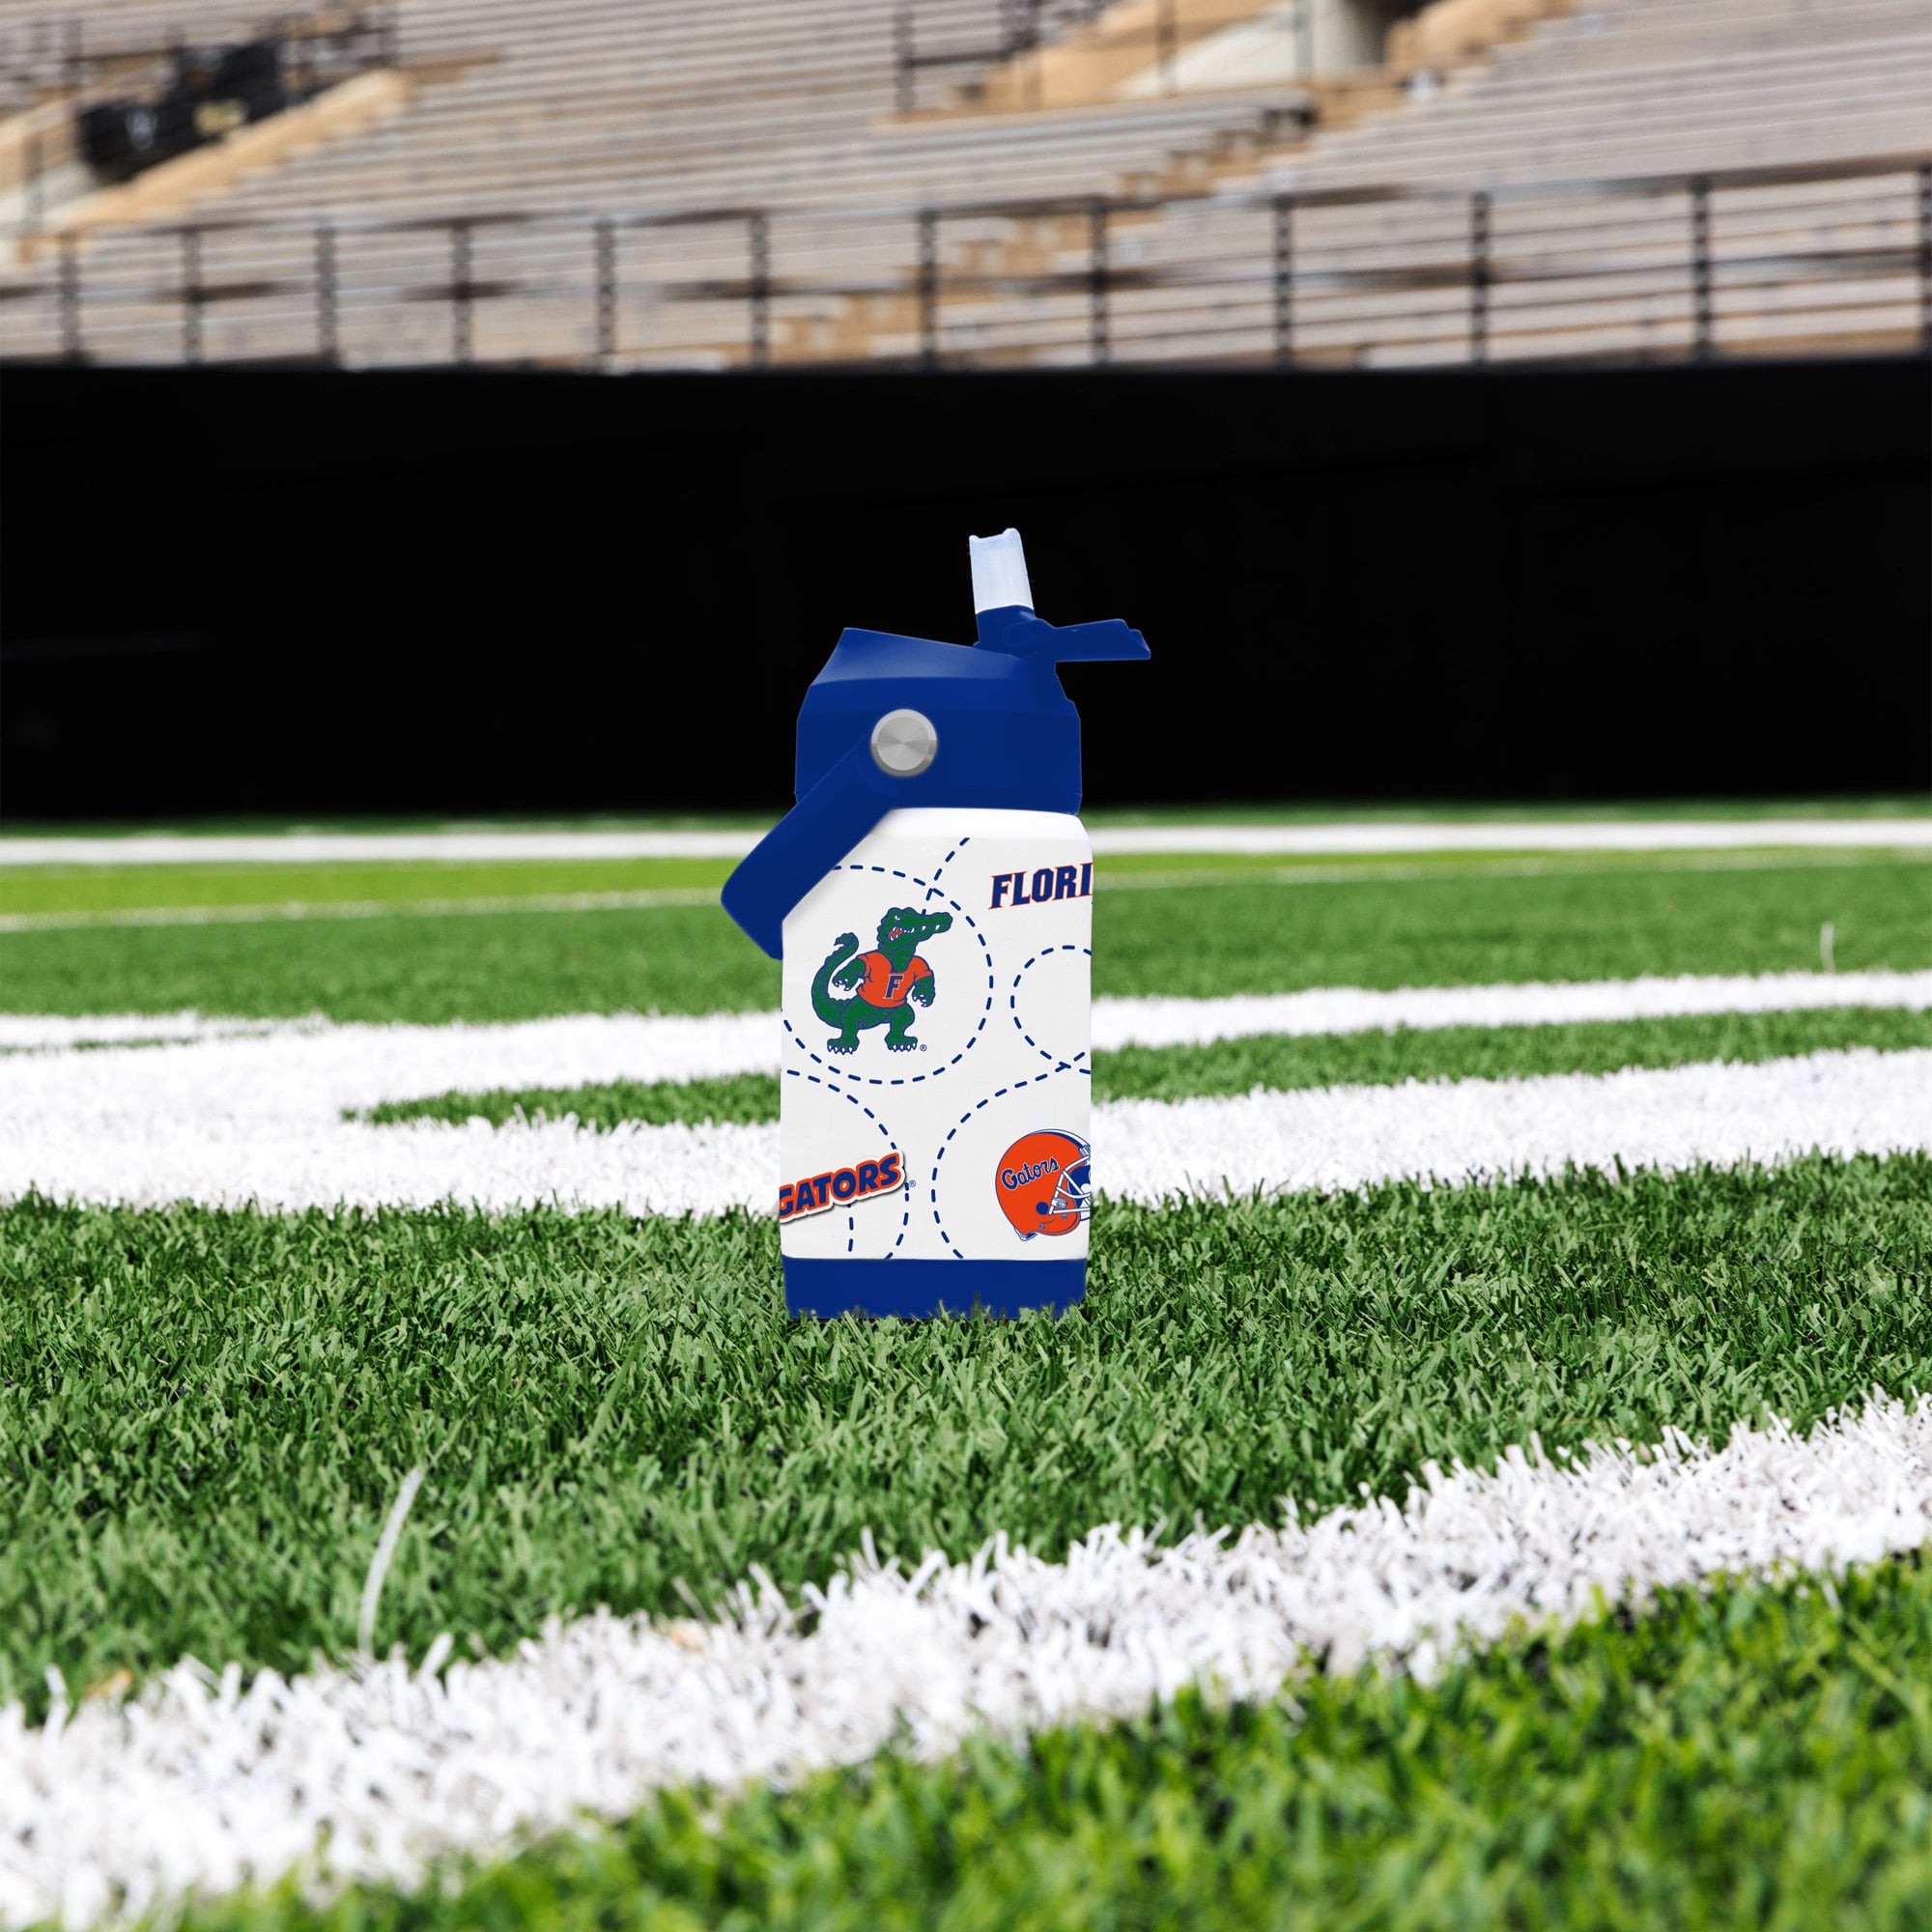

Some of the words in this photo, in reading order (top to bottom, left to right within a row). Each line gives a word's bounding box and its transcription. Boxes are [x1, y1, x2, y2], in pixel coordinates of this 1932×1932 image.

[988, 862, 1093, 910] FLORI
[883, 974, 904, 999] F
[779, 1152, 902, 1219] GATORS
[1001, 1156, 1060, 1190] Gators
